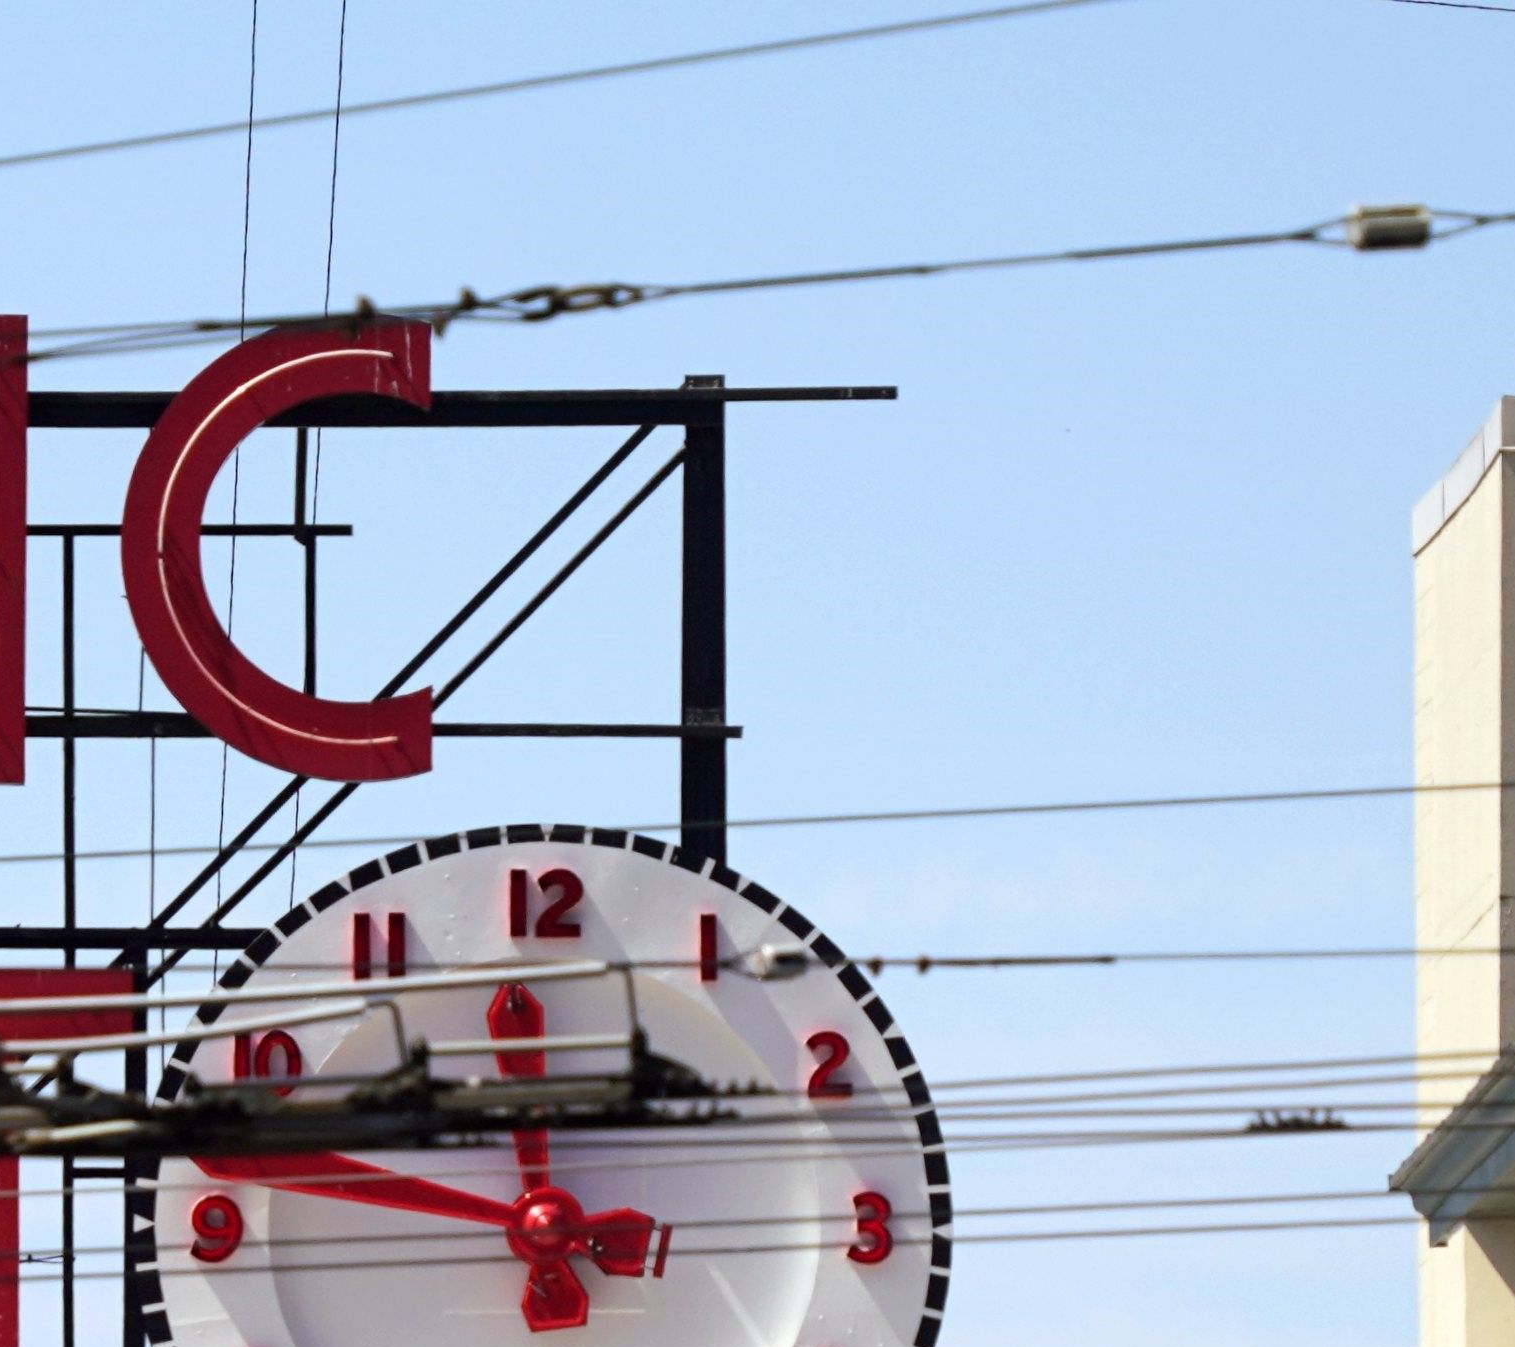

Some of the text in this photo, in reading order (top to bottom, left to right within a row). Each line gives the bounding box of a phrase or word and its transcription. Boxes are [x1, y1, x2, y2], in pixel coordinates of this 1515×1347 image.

[507, 868, 583, 939] 12
[353, 911, 407, 980] 11
[700, 914, 718, 981] 1
[233, 1030, 303, 1097] 10
[806, 1030, 853, 1097] 2
[190, 1195, 243, 1262] 9
[847, 1192, 893, 1264] 3
